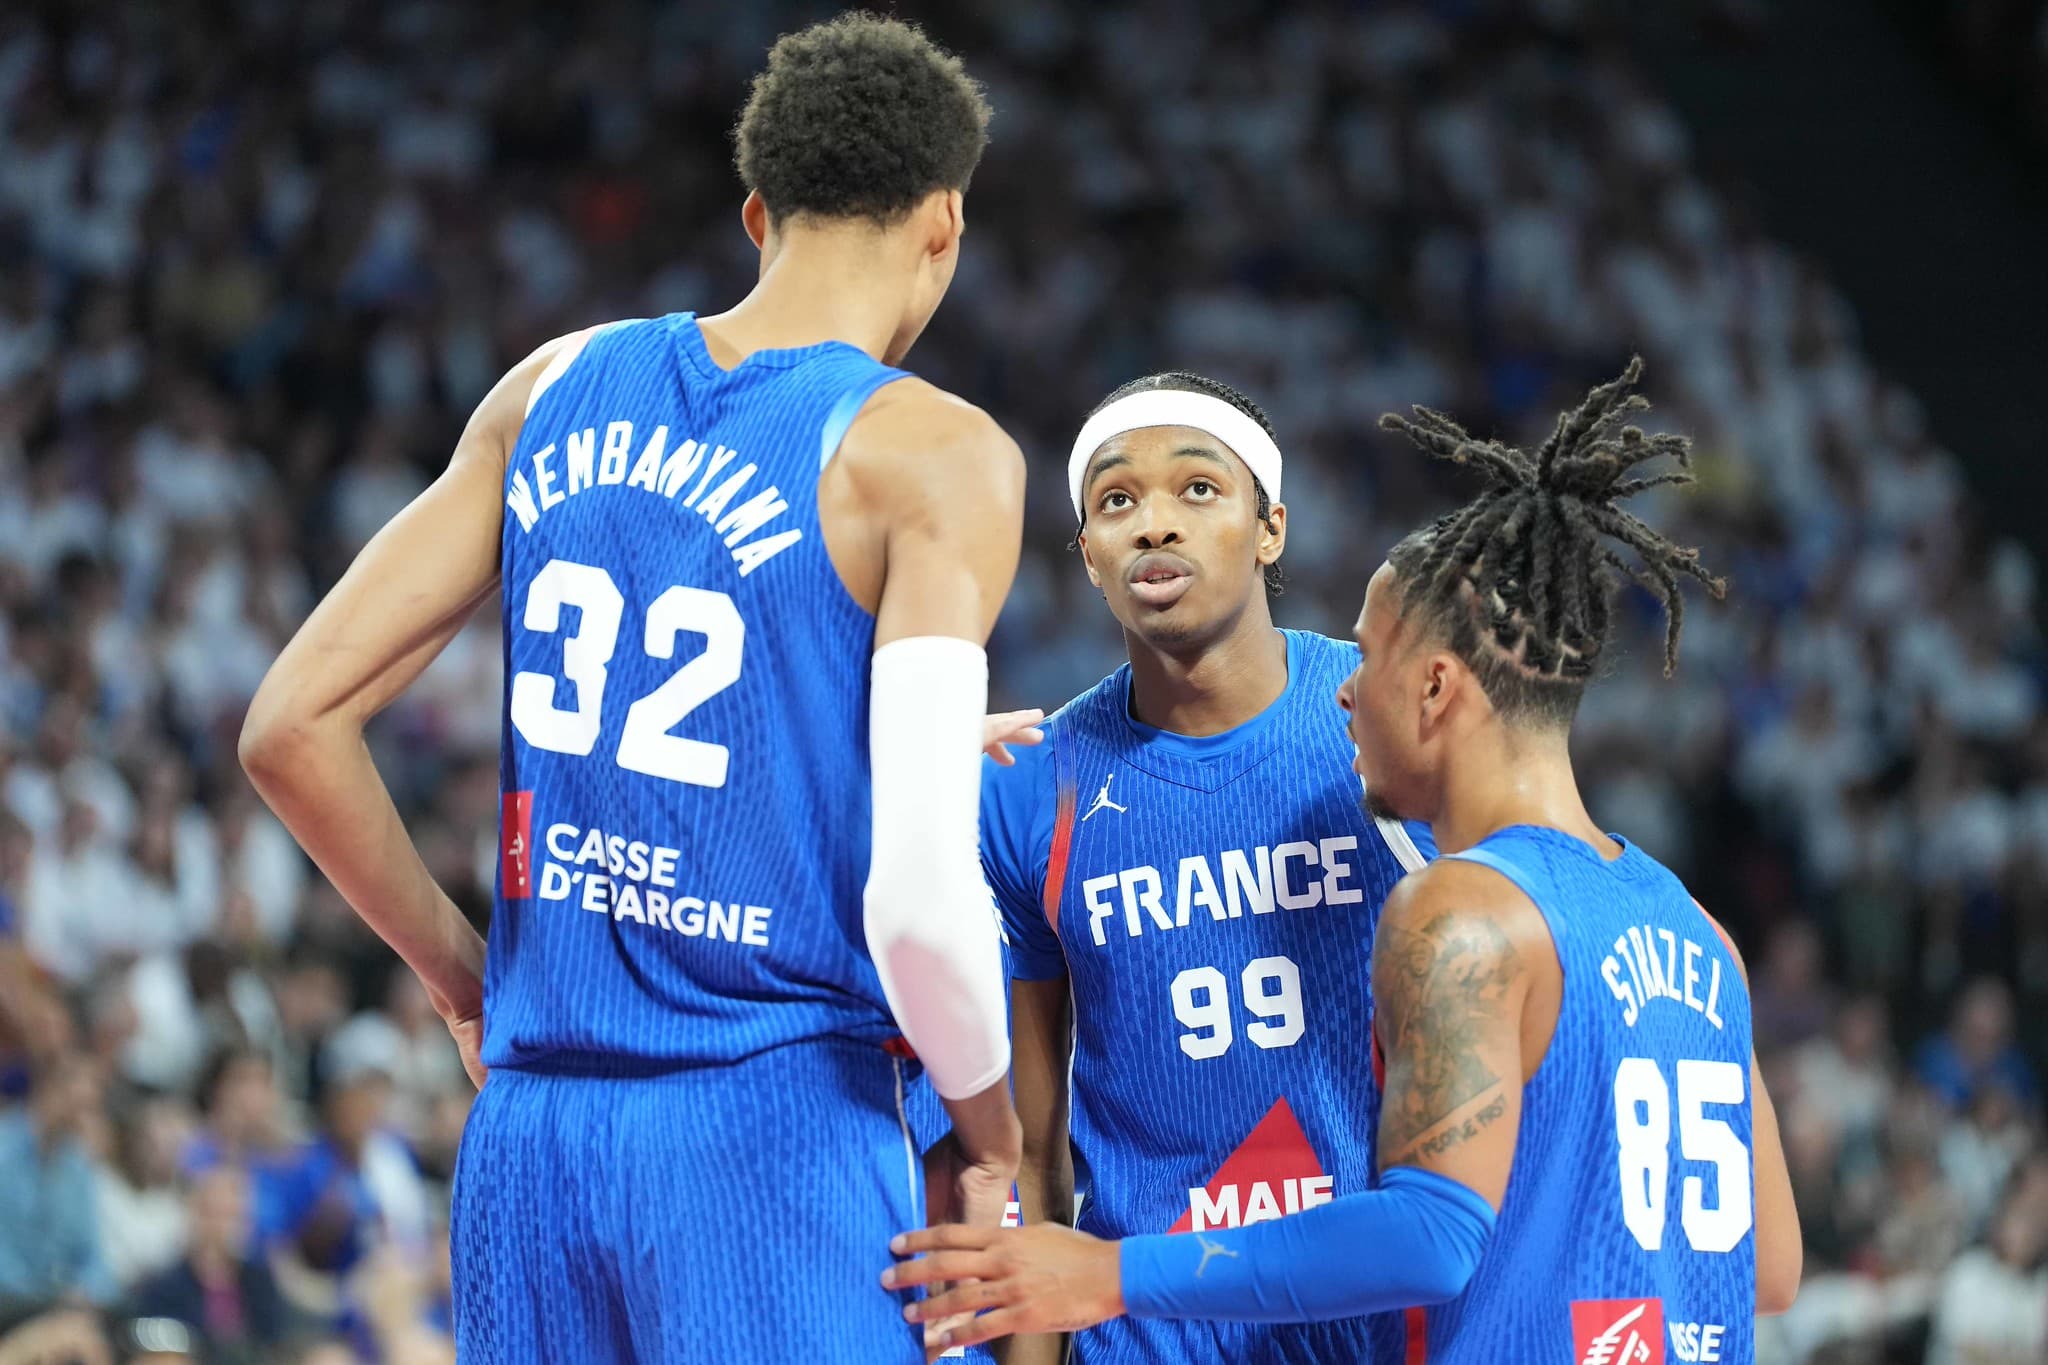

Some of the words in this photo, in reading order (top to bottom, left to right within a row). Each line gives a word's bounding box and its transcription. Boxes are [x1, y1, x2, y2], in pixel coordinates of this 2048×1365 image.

[507, 420, 802, 578] WEMBANYAMA
[510, 558, 745, 788] 32
[546, 823, 681, 888] CASSE
[1082, 836, 1363, 946] FRANCE
[1170, 955, 1305, 1060] 99
[1601, 924, 1723, 1031] STRAZEL
[1614, 1057, 1753, 1254] 85
